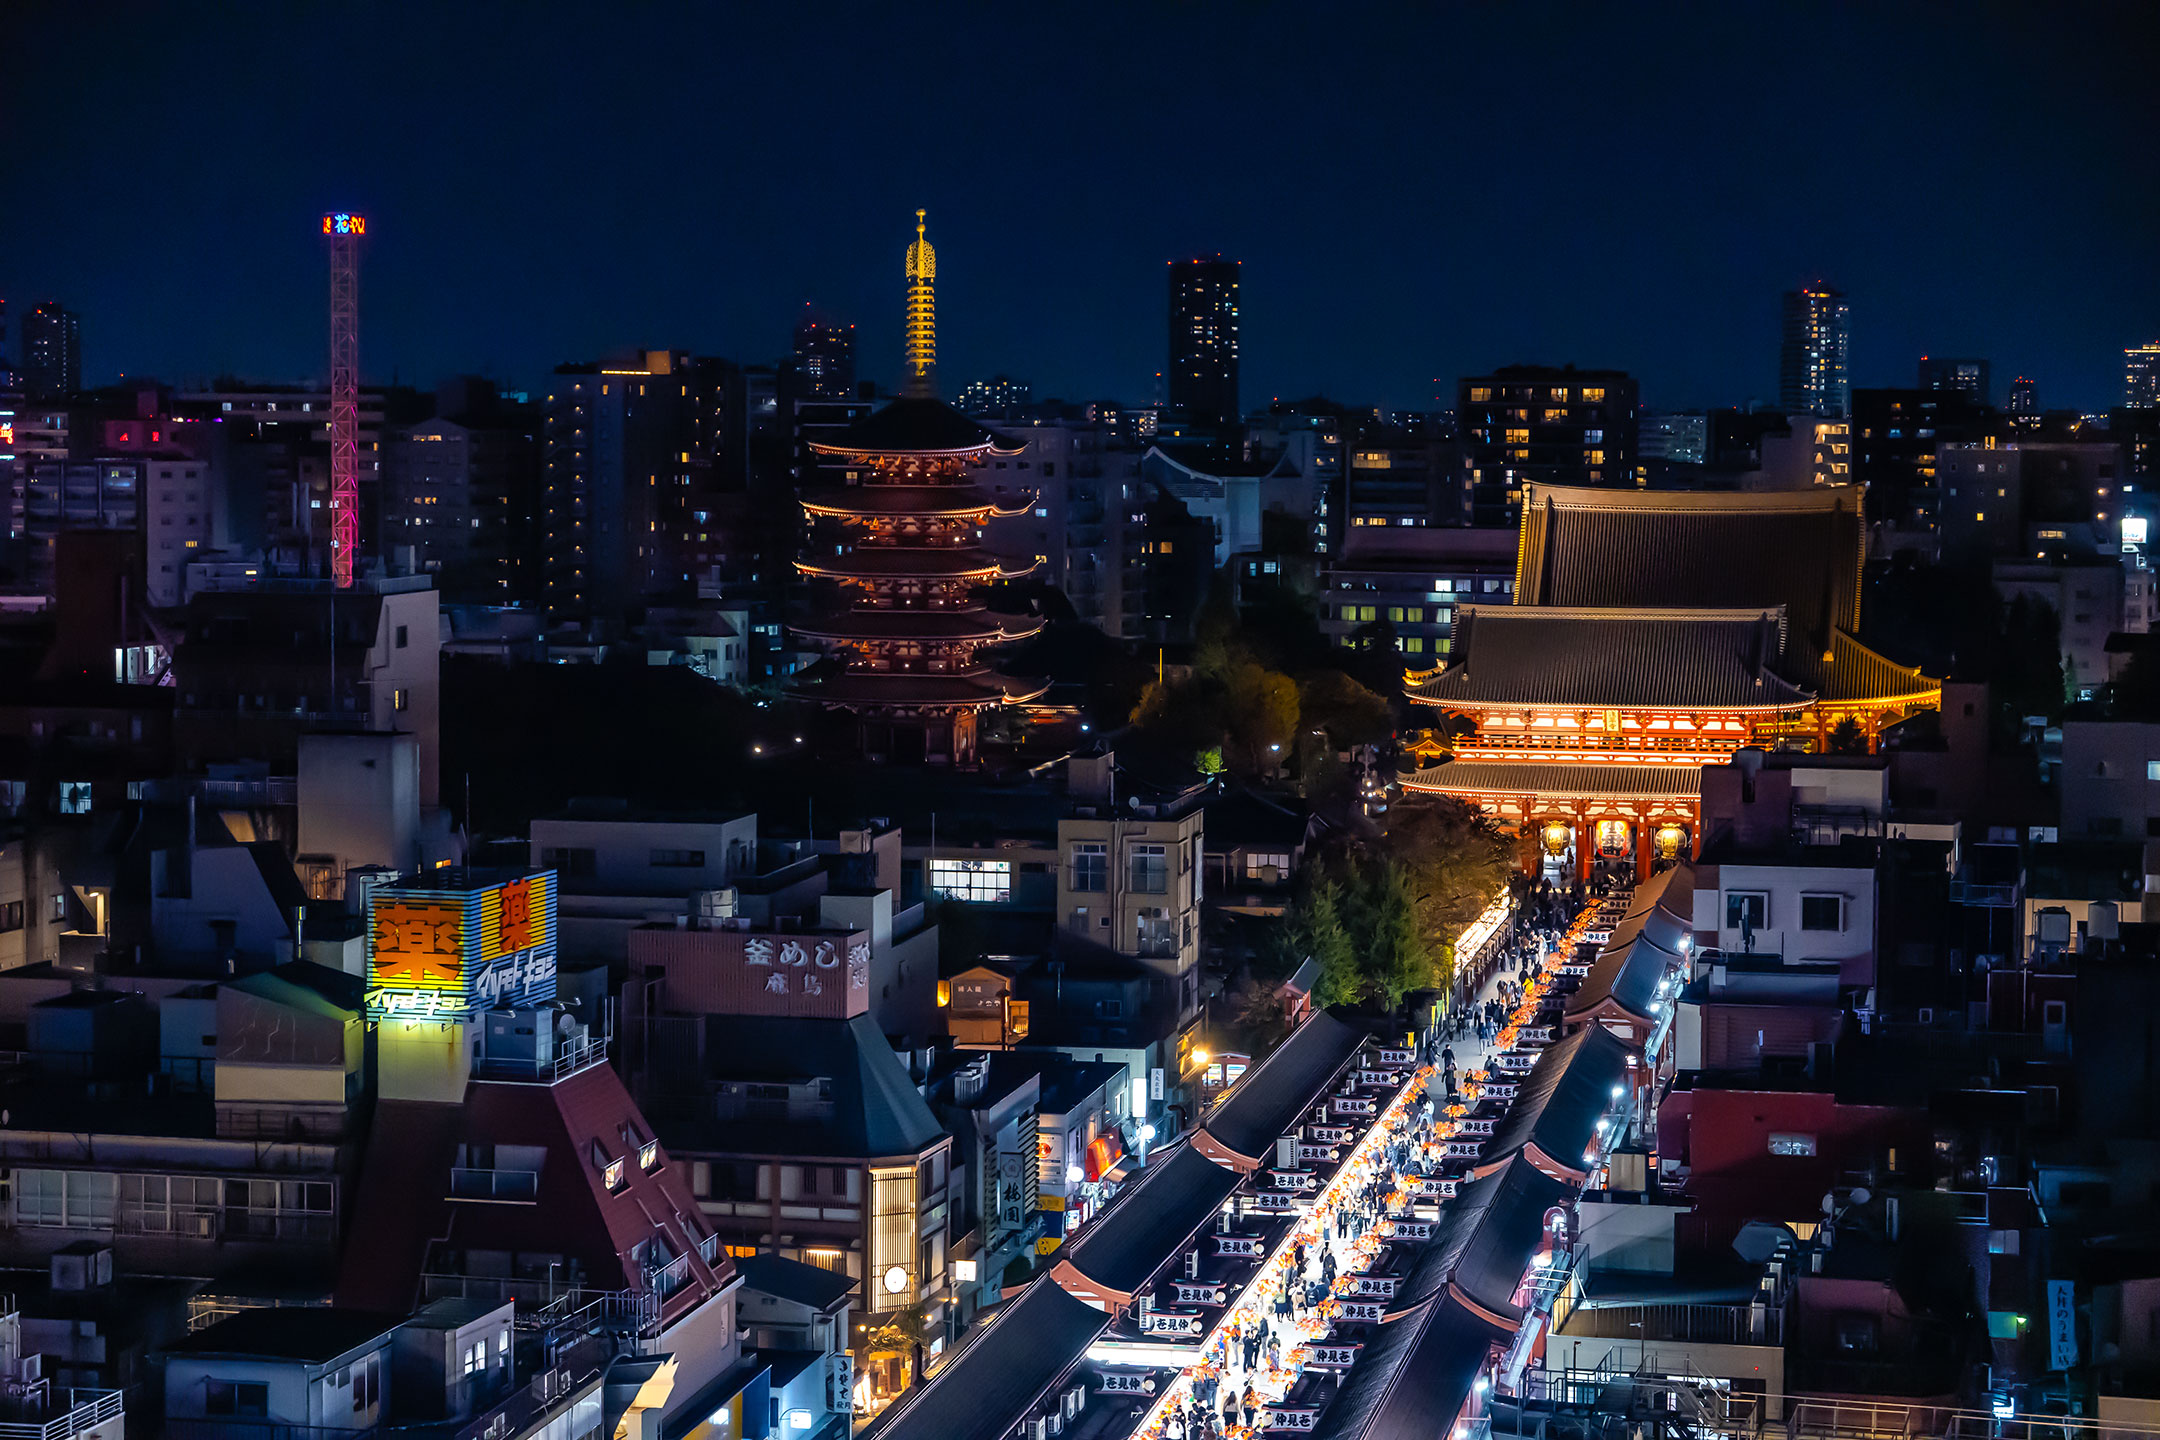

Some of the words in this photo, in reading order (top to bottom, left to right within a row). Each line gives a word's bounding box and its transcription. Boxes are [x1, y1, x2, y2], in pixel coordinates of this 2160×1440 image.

[500, 879, 533, 954] 薬
[375, 904, 462, 981] 薬
[744, 938, 840, 969] 釜めし
[364, 986, 471, 1016] マツモトキヨシ
[476, 950, 557, 1005] マツモトキヨシ
[1003, 1181, 1022, 1223] 梅園
